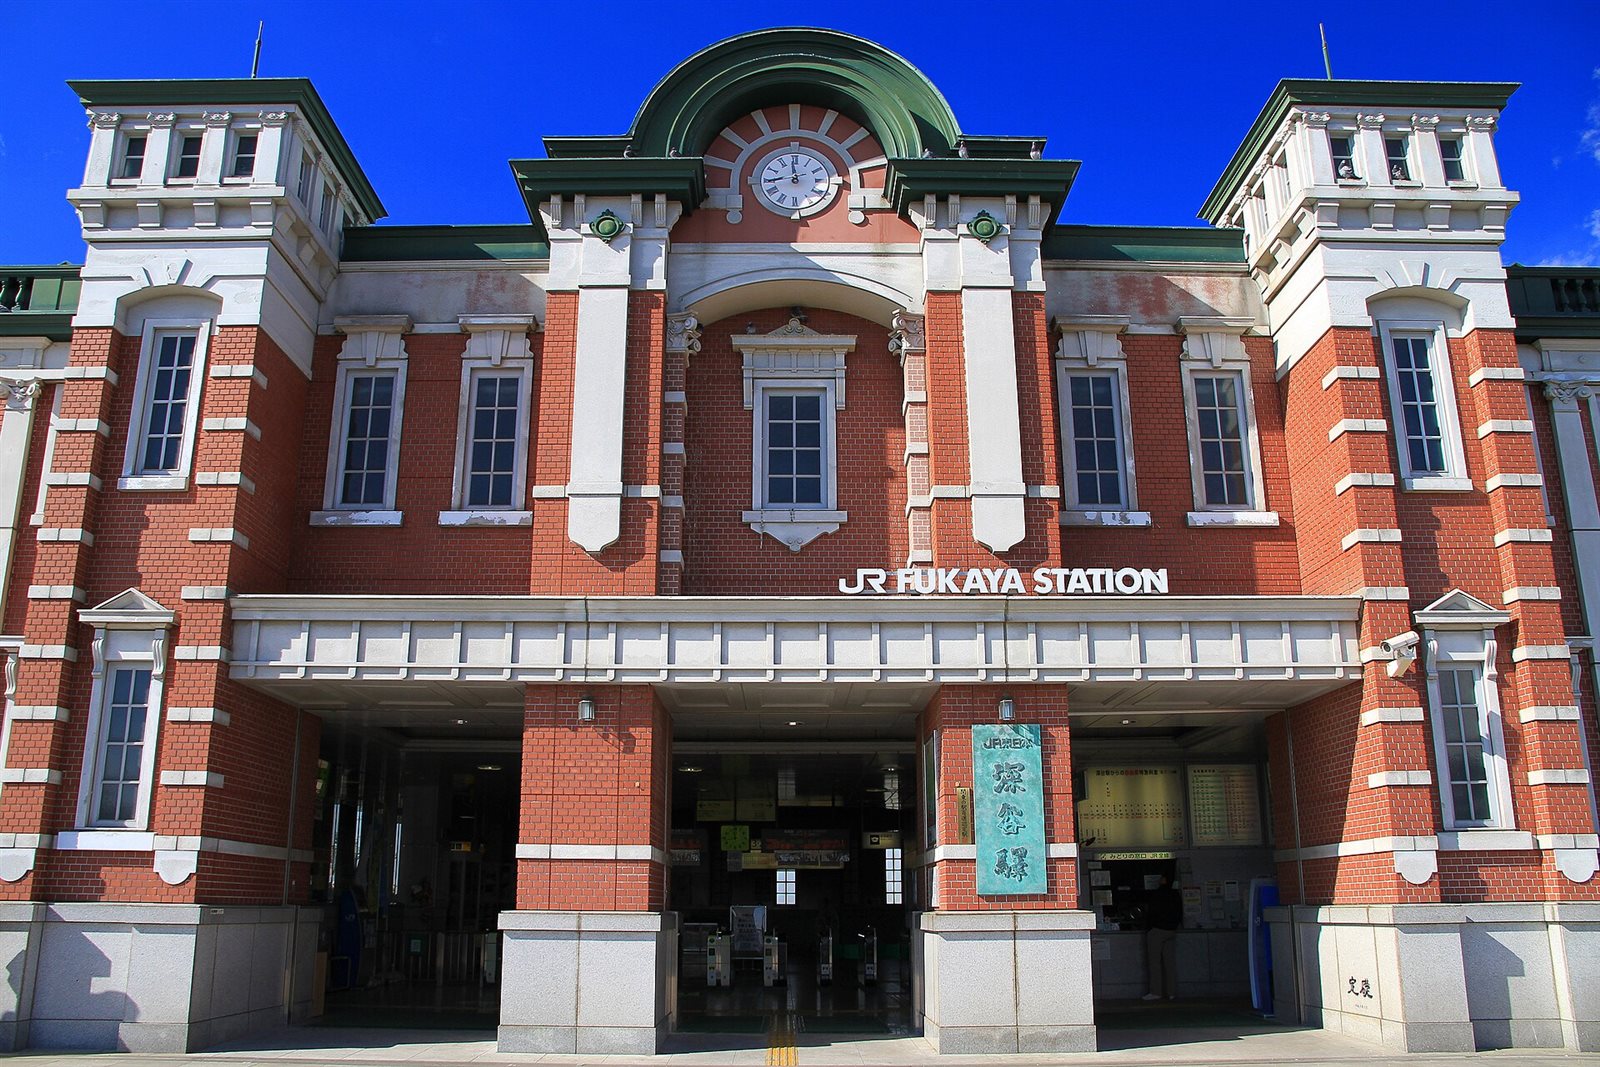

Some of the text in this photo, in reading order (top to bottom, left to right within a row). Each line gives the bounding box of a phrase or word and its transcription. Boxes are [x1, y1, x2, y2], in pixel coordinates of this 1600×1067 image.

[838, 567, 1169, 594] JR FUKAYA STATION
